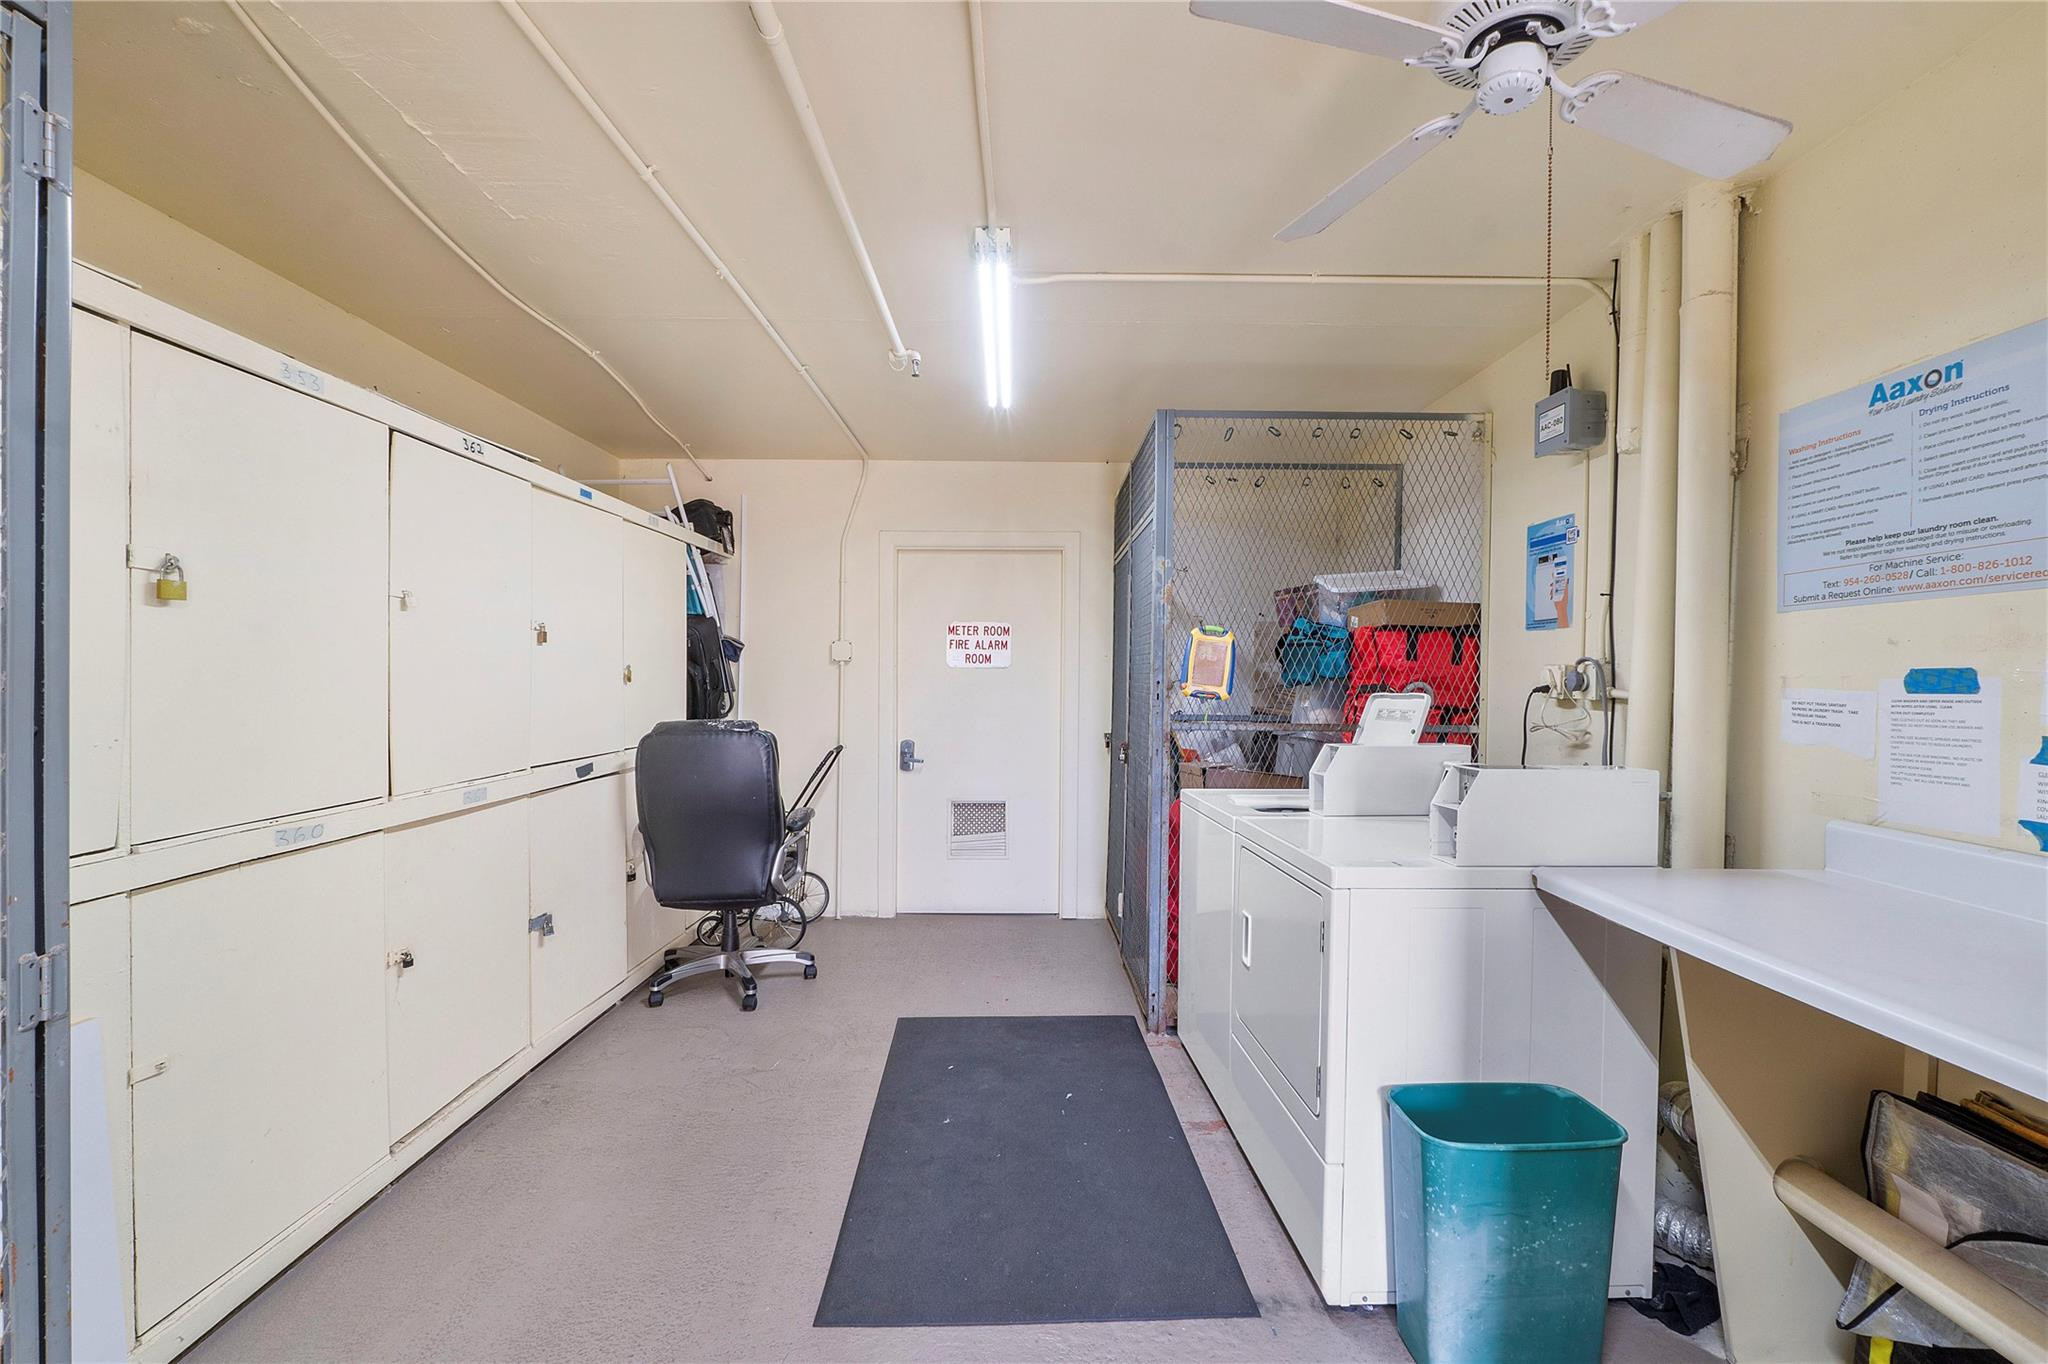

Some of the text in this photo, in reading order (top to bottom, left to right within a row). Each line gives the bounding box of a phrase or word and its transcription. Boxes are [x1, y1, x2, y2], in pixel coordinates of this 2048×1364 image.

[281, 362, 320, 391] 353
[1868, 361, 1964, 408] Aaxon
[1919, 384, 2010, 417] Drying Instructions
[462, 437, 484, 455] 362
[1788, 442, 1816, 455] Washing
[1818, 429, 1861, 447] Instructions
[1845, 538, 1866, 546] Please
[1868, 534, 1882, 543] help
[1884, 532, 1901, 541] keep
[1918, 523, 1948, 534] laundry
[1949, 520, 1971, 529] room
[1973, 515, 1999, 525] clean.
[1823, 580, 1841, 589] Text:
[1916, 568, 1938, 578] Call:
[1940, 555, 2033, 575] 1-800-826-1012
[1869, 552, 1964, 572] For Machine Service:
[1793, 593, 1820, 603] Submit
[1828, 589, 1860, 600] Request
[1863, 585, 1895, 596] Online:
[948, 625, 1010, 636] METER ROOM
[949, 640, 1008, 650] FIRE ALARM
[965, 654, 991, 664] ROOM
[276, 823, 324, 847] 360
